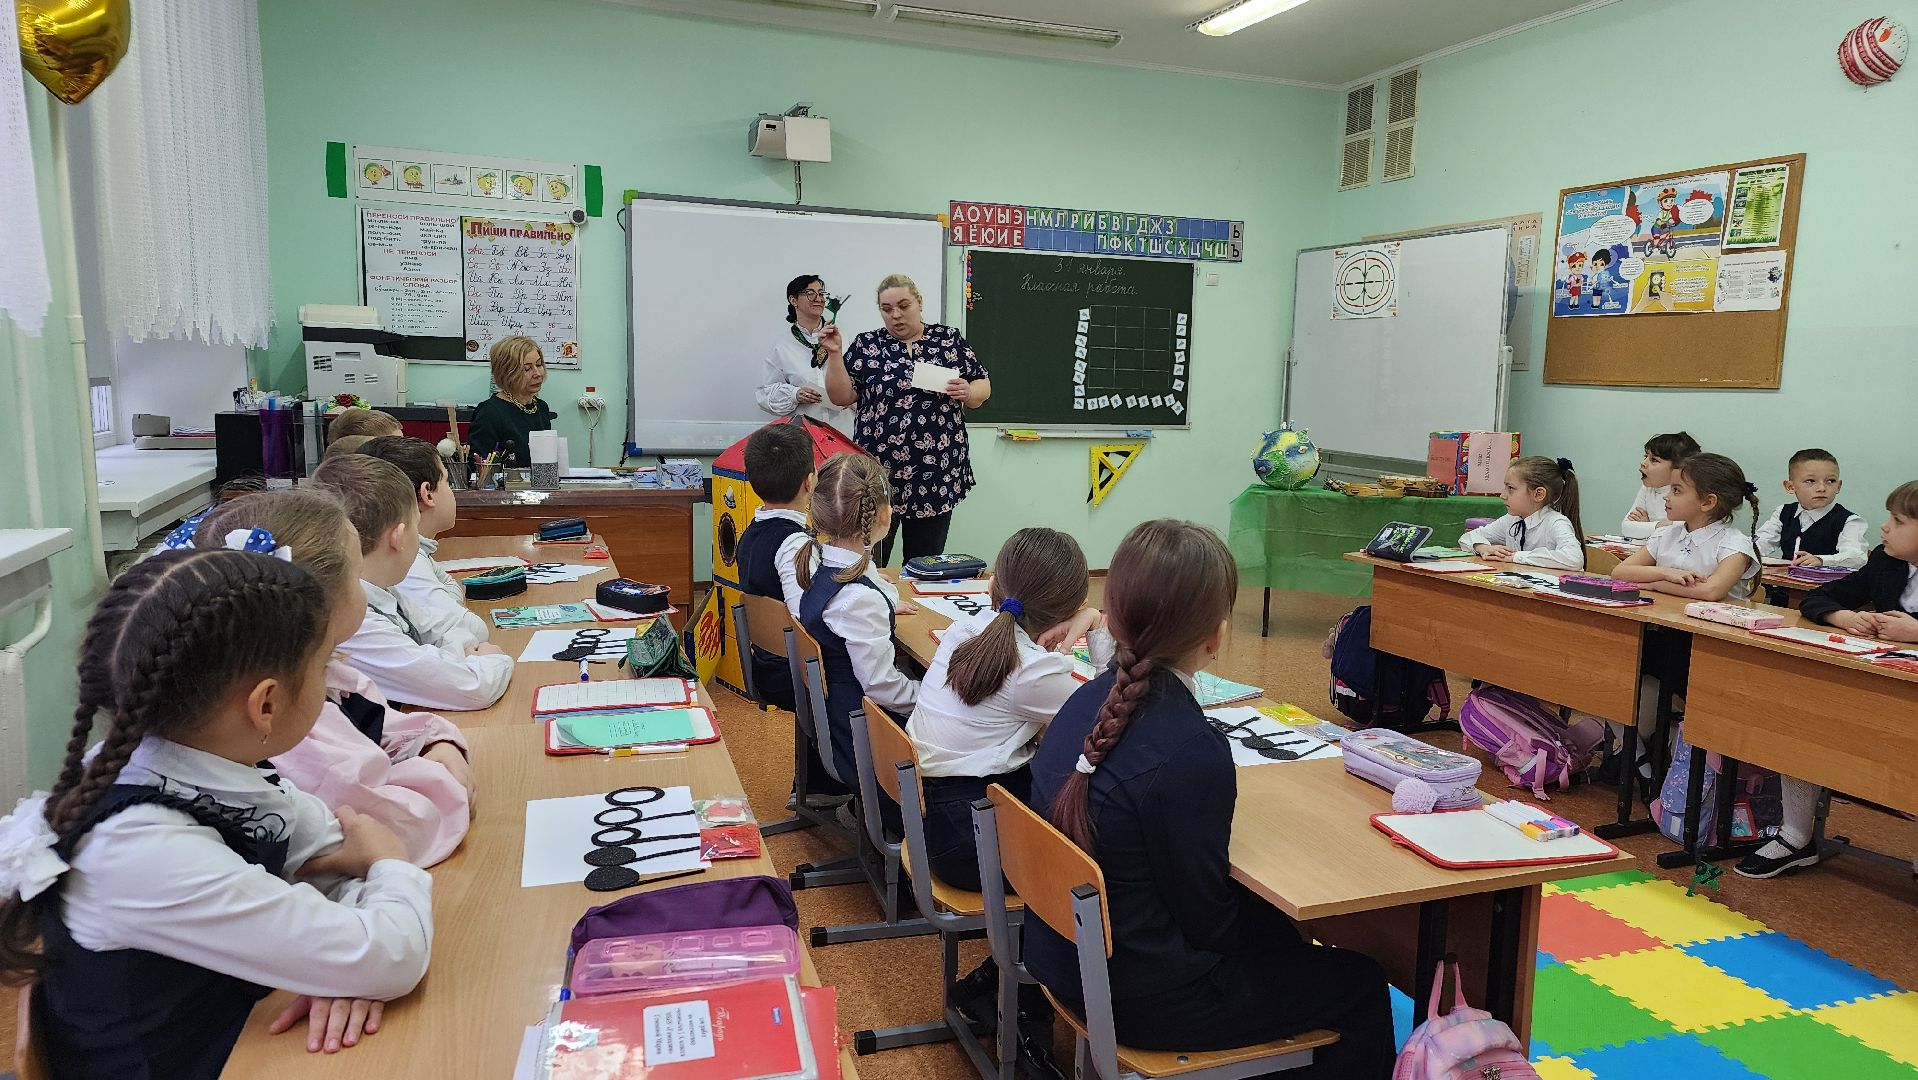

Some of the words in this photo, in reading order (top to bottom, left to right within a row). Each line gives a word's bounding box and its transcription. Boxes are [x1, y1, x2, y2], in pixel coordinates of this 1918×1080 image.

[366, 212, 409, 220] ПЕРЕНОСИ
[410, 214, 457, 224] ПРАВИЛЬНО
[396, 249, 437, 258] ПЕРЕНОСИ
